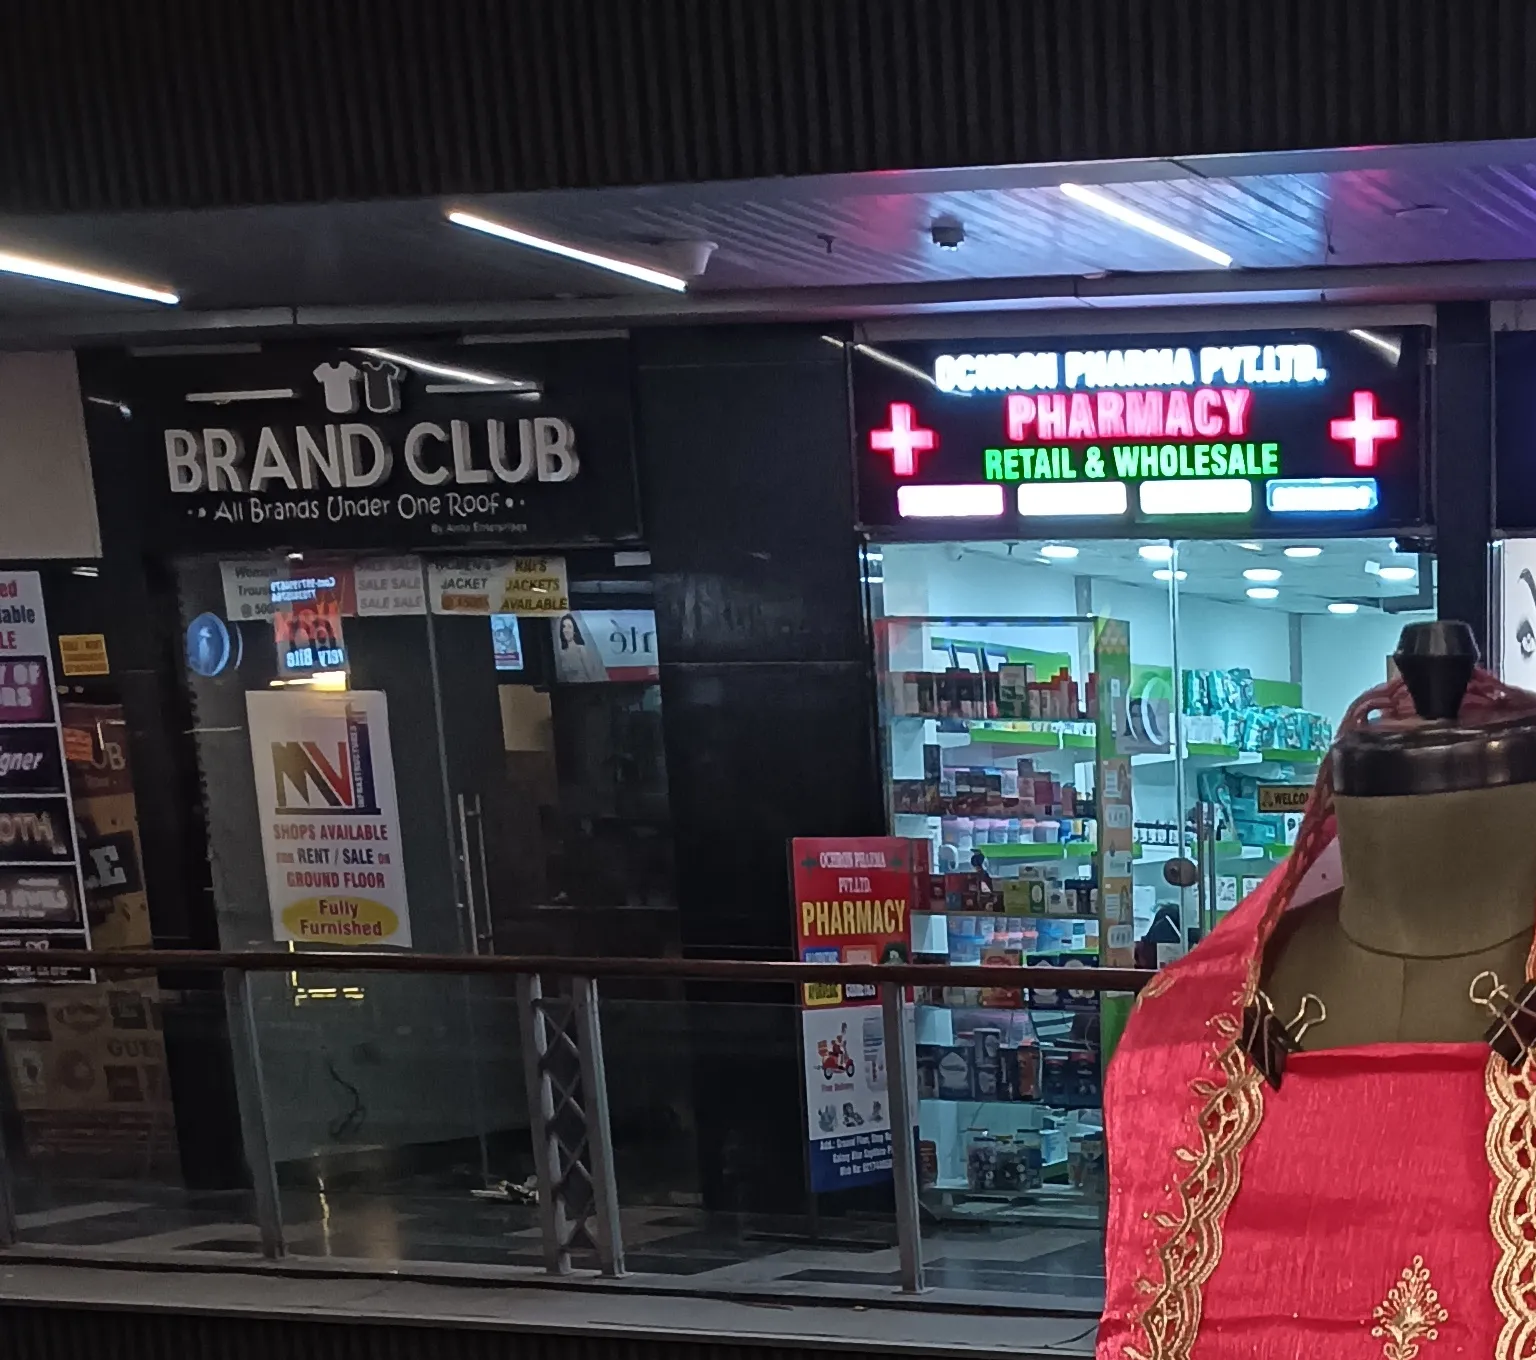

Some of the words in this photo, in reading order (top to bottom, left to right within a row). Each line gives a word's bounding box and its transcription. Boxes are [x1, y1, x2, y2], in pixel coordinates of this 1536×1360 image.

[1007, 389, 1249, 441] PHARMACY
[164, 423, 392, 493] BRAND
[405, 417, 579, 486] CLUB
[985, 447, 1076, 480] RETAIL
[1085, 448, 1105, 479] &
[1113, 443, 1278, 476] WHOLESALE
[214, 499, 244, 522] All
[250, 498, 319, 523] Brands
[327, 496, 390, 522] Under
[398, 493, 440, 520] One
[448, 492, 500, 516] Roof
[359, 578, 388, 591] SALE
[391, 577, 420, 590] SALE
[441, 577, 488, 590] JACKET
[506, 578, 560, 592] JACKETS
[500, 597, 568, 611] AVAILABLE
[273, 824, 316, 841] SHOPS
[320, 824, 388, 841] AVAILABLE
[297, 849, 330, 865] RENT
[343, 848, 374, 865] SALE
[287, 872, 340, 888] GROUND
[344, 872, 386, 889] FLOOR
[319, 900, 359, 917] Fully
[802, 899, 905, 936] PHARMACY
[300, 919, 382, 936] Furnished
